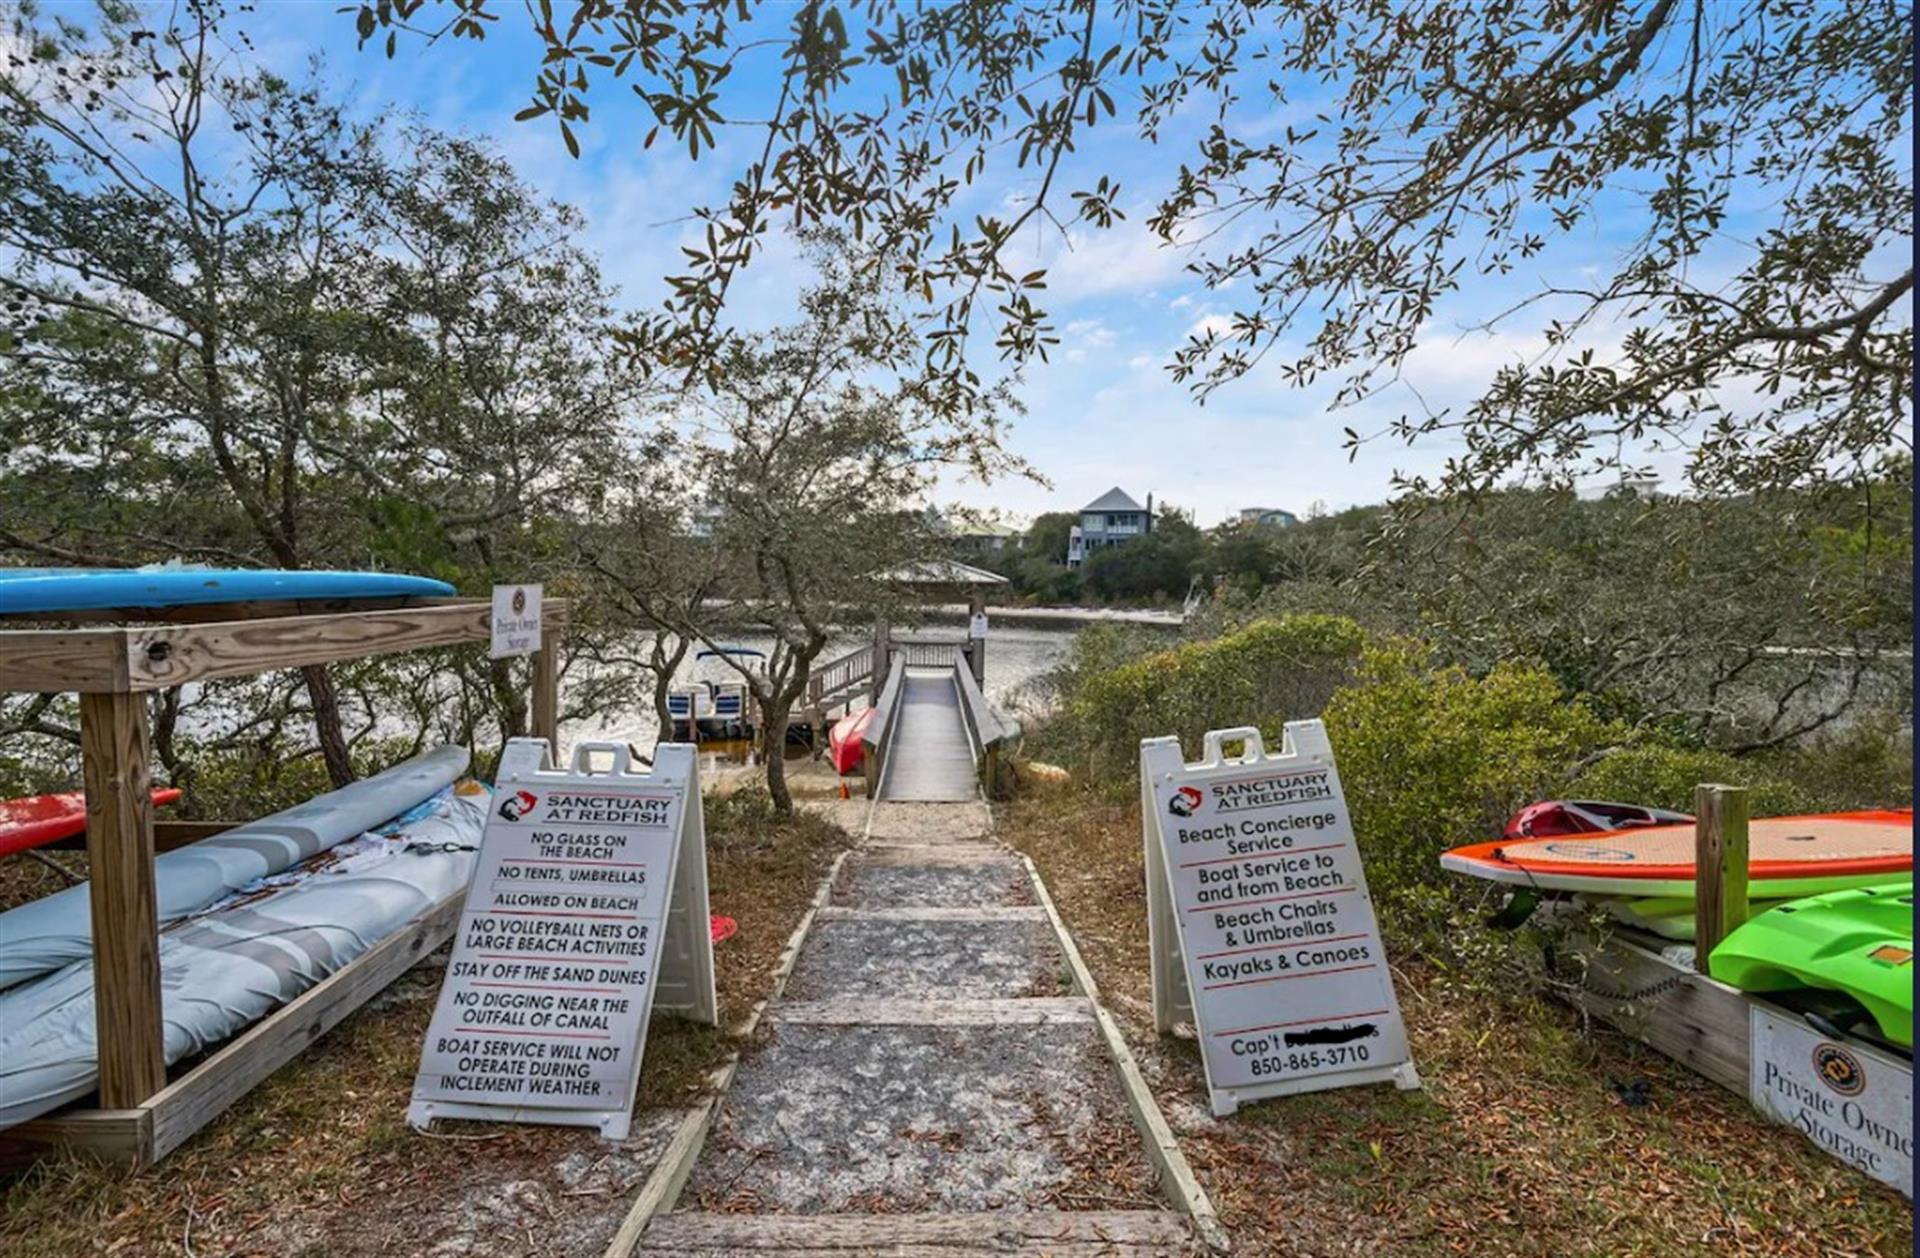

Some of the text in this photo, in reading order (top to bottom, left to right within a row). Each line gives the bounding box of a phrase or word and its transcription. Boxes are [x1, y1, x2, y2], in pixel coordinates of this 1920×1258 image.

[1211, 773, 1328, 798] SANCTUARY
[547, 796, 671, 811] SANCTUARY
[1217, 786, 1331, 809] AT REDFISH
[547, 809, 667, 824] AT REDFISH
[1178, 812, 1336, 844] Beach Concierge
[531, 833, 627, 847] NO GLASS ON
[1228, 834, 1293, 855] Service
[540, 846, 613, 859] THE BEACH
[498, 866, 645, 884] NO TENTS, UMBRELLAS
[1198, 853, 1334, 883] Boat Service to
[1197, 870, 1344, 903] and from Beach
[494, 894, 639, 911] ALLOWED ON BEACH
[1214, 900, 1338, 929] Beach Chairs
[471, 918, 649, 940] NO VOLLEYBALL NETS OR
[1226, 919, 1335, 947] & Umbrellas
[465, 935, 647, 957] LARGE BEACH ACTIVITIES
[452, 962, 647, 986] STAY OFF THE SAND DUNES
[1203, 946, 1370, 981] Kayaks & Canoes
[453, 992, 629, 1014] NO DIGGING NEAR THE
[462, 1009, 609, 1030] OUTFALL OF CANAL
[437, 1038, 621, 1062] BOAT SERVICE WILL NOT
[1231, 1034, 1280, 1056] Cap't
[458, 1057, 591, 1078] OPERATE DURING
[1251, 1044, 1370, 1076] 850-865-3710
[440, 1076, 600, 1096] INCLEMENT WEATHER
[1764, 1060, 1834, 1117] Private
[1800, 1107, 1882, 1172] Storage
